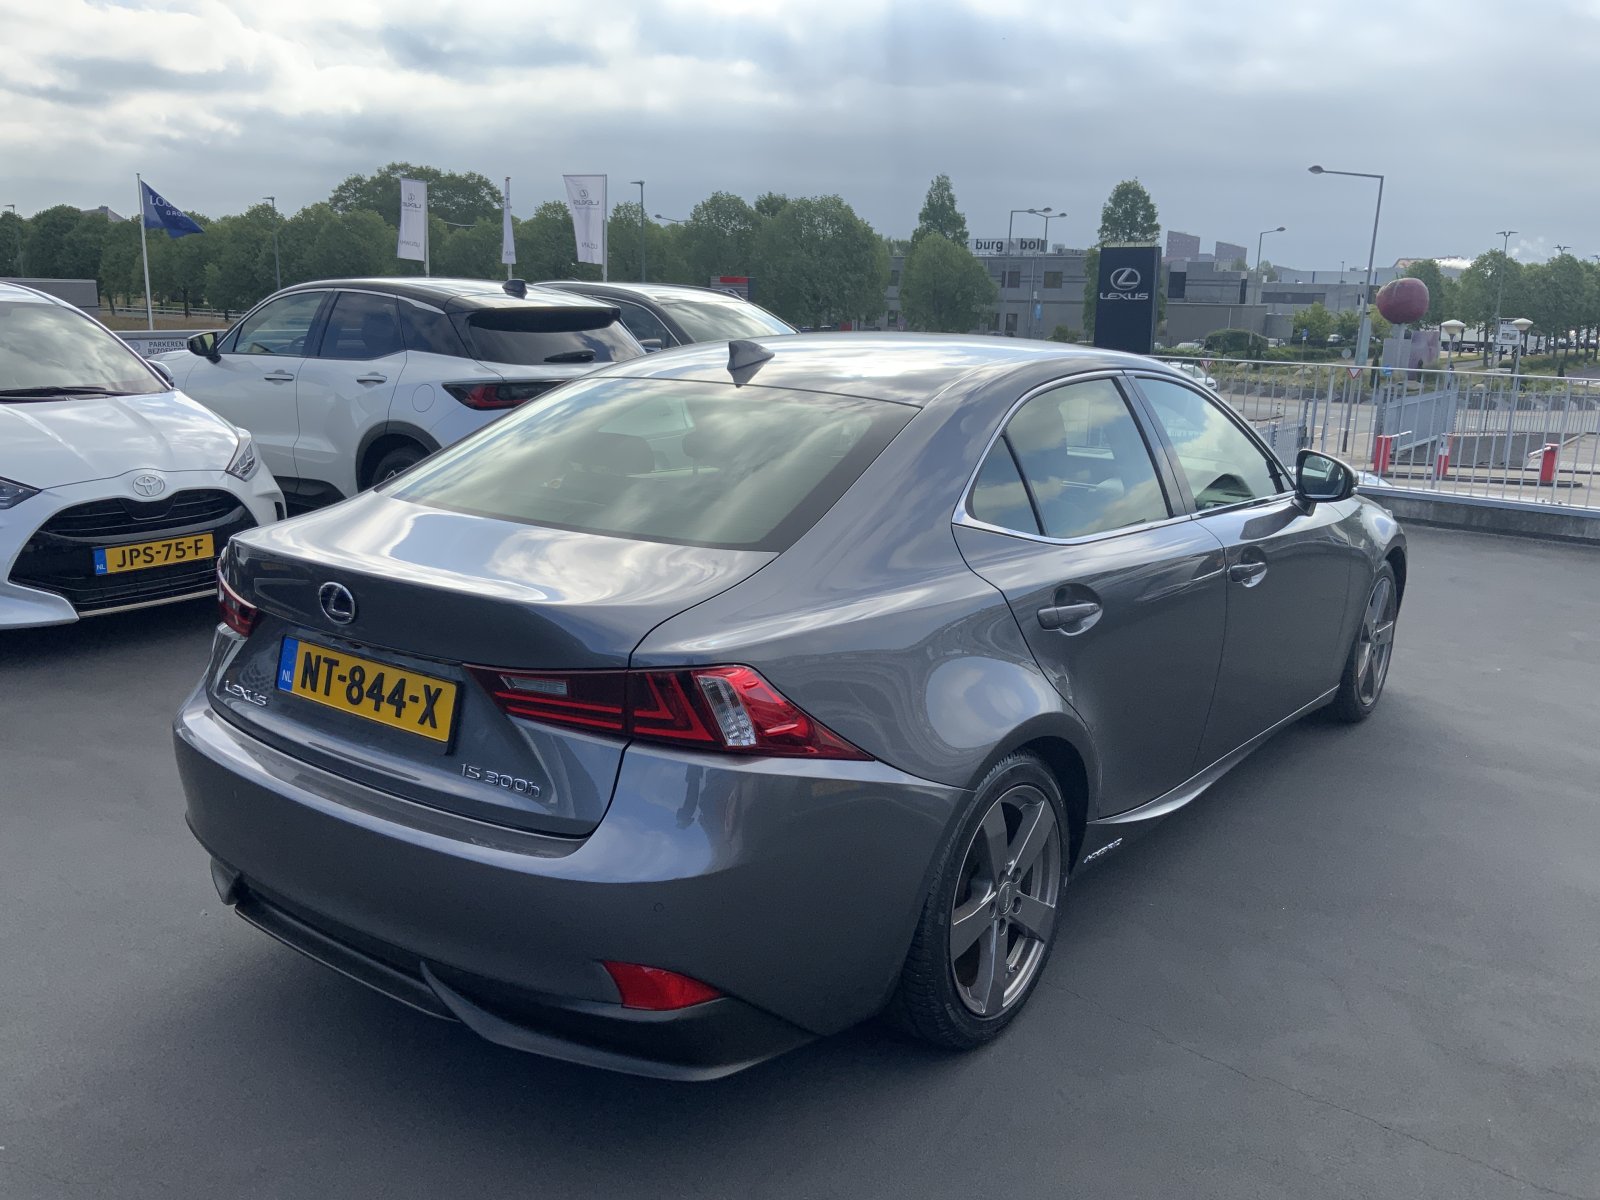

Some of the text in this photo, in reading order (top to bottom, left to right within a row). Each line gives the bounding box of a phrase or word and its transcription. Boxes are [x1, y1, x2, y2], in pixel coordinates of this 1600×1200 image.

[975, 238, 1004, 252] burg
[1099, 292, 1149, 300] LEXUS
[116, 538, 204, 568] JPS-75-F
[225, 680, 267, 706] LEXUS
[281, 651, 443, 729] NL NT-844-X
[461, 763, 541, 798] IS 300h
